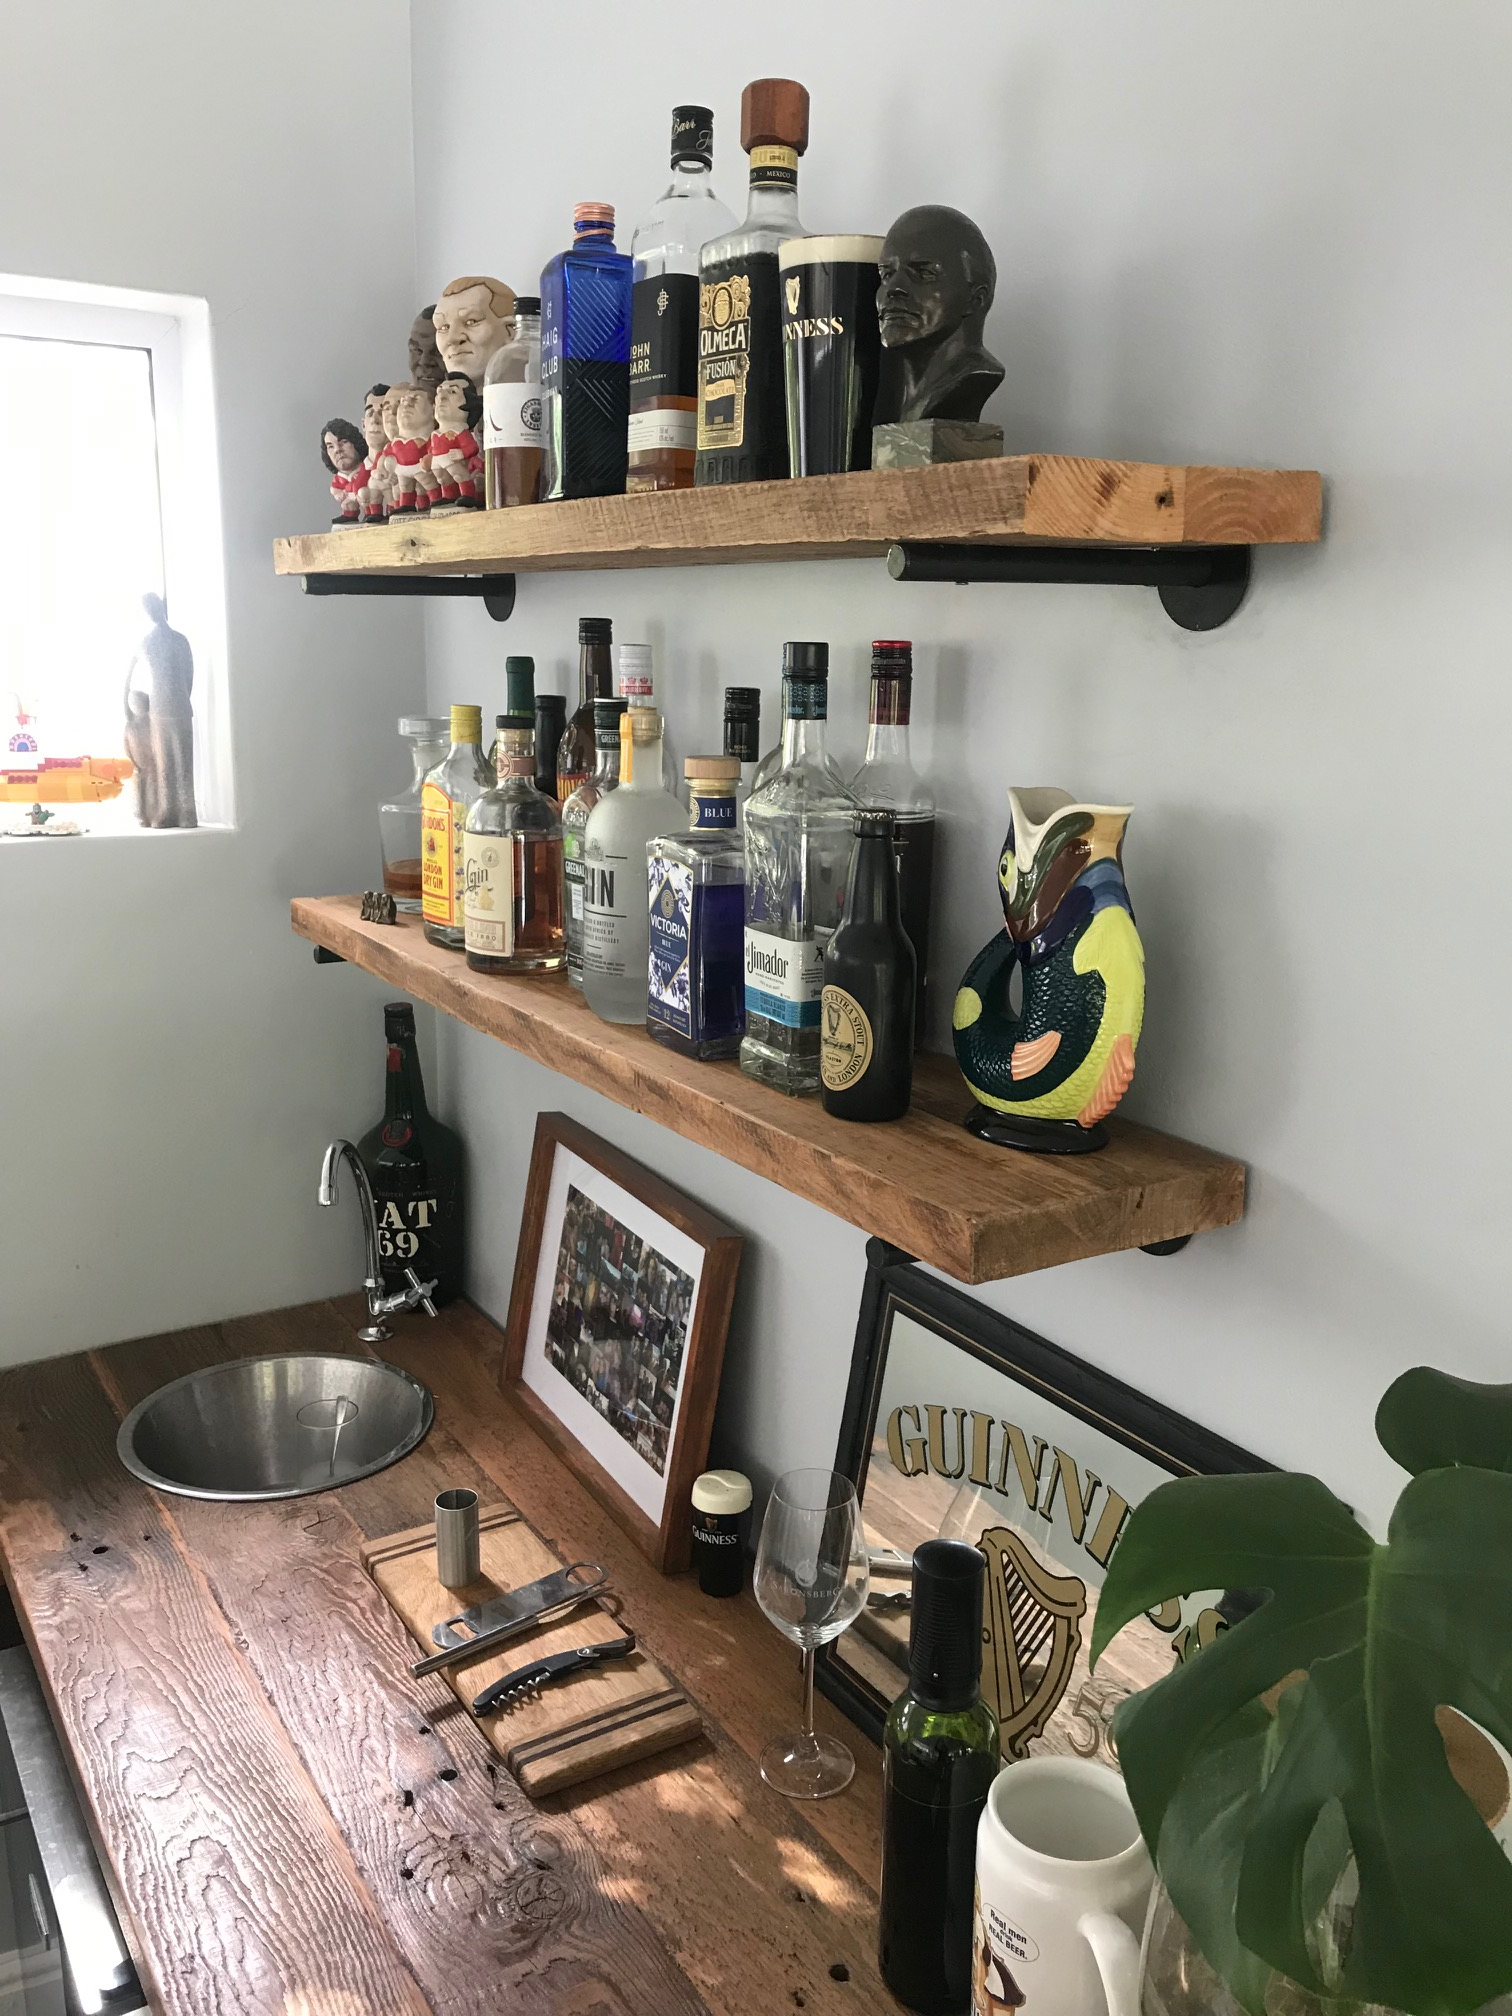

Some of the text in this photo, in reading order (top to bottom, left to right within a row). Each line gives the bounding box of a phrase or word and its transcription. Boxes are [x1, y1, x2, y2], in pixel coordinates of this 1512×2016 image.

[766, 171, 791, 179] MEXICO
[541, 326, 558, 352] HAIG
[700, 323, 747, 356] OLMECA
[785, 316, 844, 340] NNESS
[541, 356, 558, 380] CLUB
[706, 356, 737, 380] FUSIÓN
[601, 734, 620, 743] GREEN
[704, 807, 733, 818] BLUE
[424, 861, 443, 875] LONDON
[424, 873, 443, 889] DRY GIN
[650, 913, 688, 940] VICTORIA
[660, 958, 672, 974] GIN
[747, 941, 789, 979] Jimador
[830, 993, 854, 1016] EXTRA
[852, 1015, 865, 1047] STOUT
[827, 1074, 837, 1083] AND
[837, 1054, 863, 1083] LONDON
[374, 1199, 438, 1230] AT
[377, 1229, 420, 1258] 69
[692, 1524, 739, 1545] GUINNESS
[990, 1908, 1028, 1945] Real men
[1000, 1929, 1013, 1943] drink
[988, 1922, 1028, 1960] REAL BEER.
